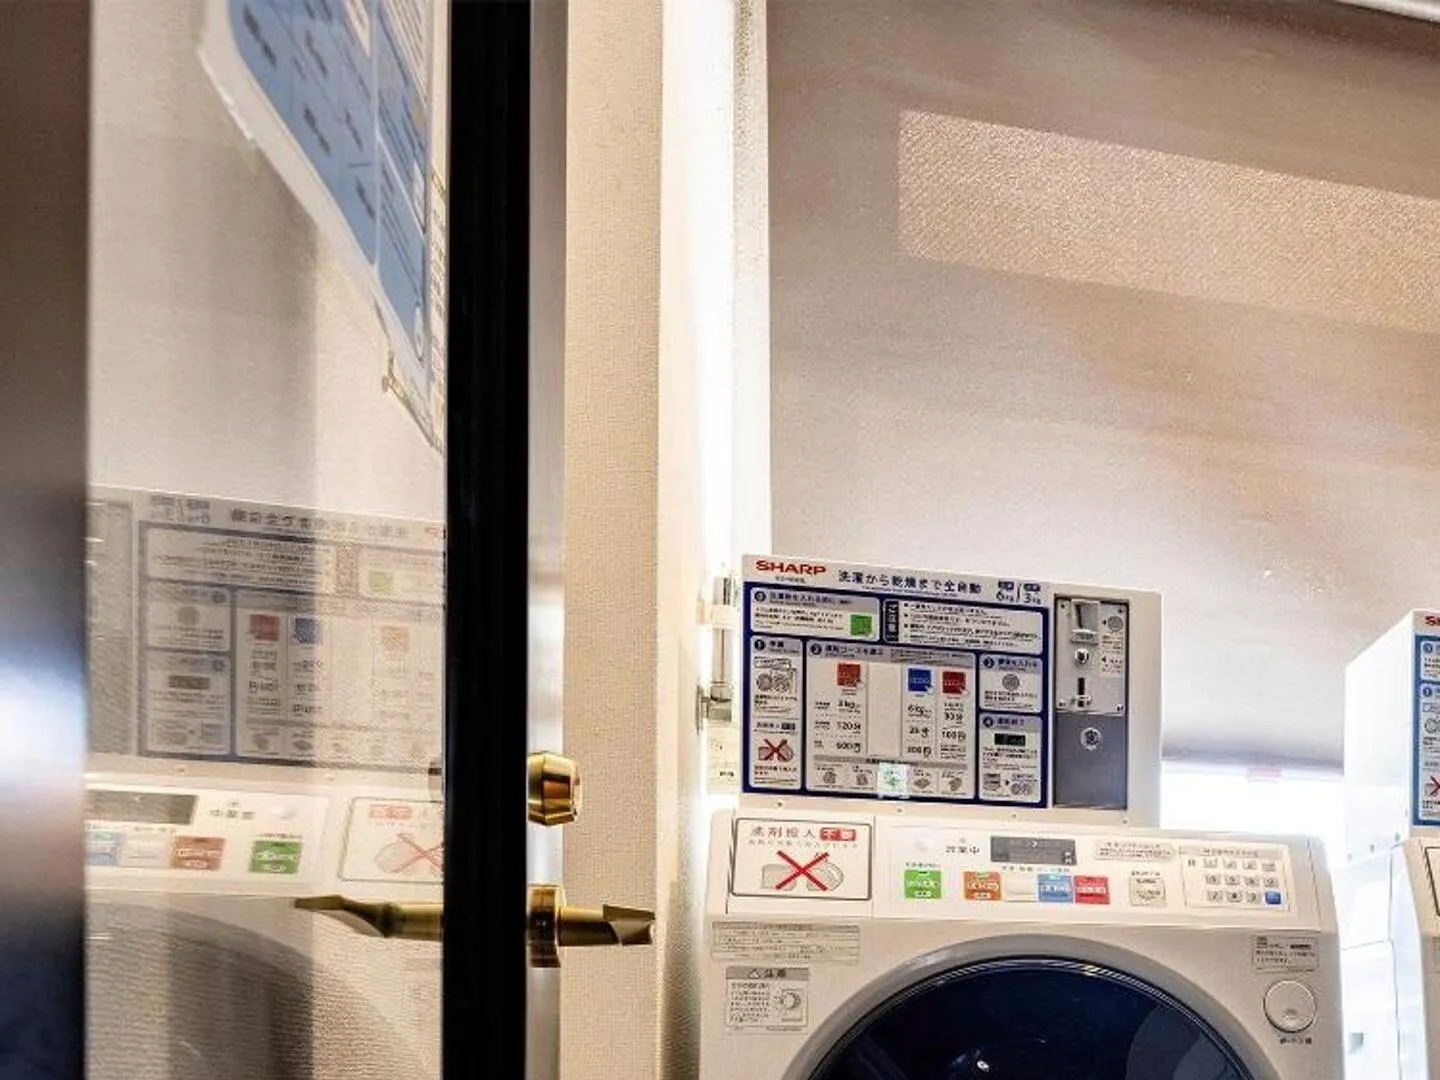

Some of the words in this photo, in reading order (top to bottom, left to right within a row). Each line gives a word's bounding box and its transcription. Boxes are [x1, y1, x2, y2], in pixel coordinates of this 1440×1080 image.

[756, 560, 826, 576] SHARP
[838, 569, 982, 595] 洗濯から乾燥まで全自動
